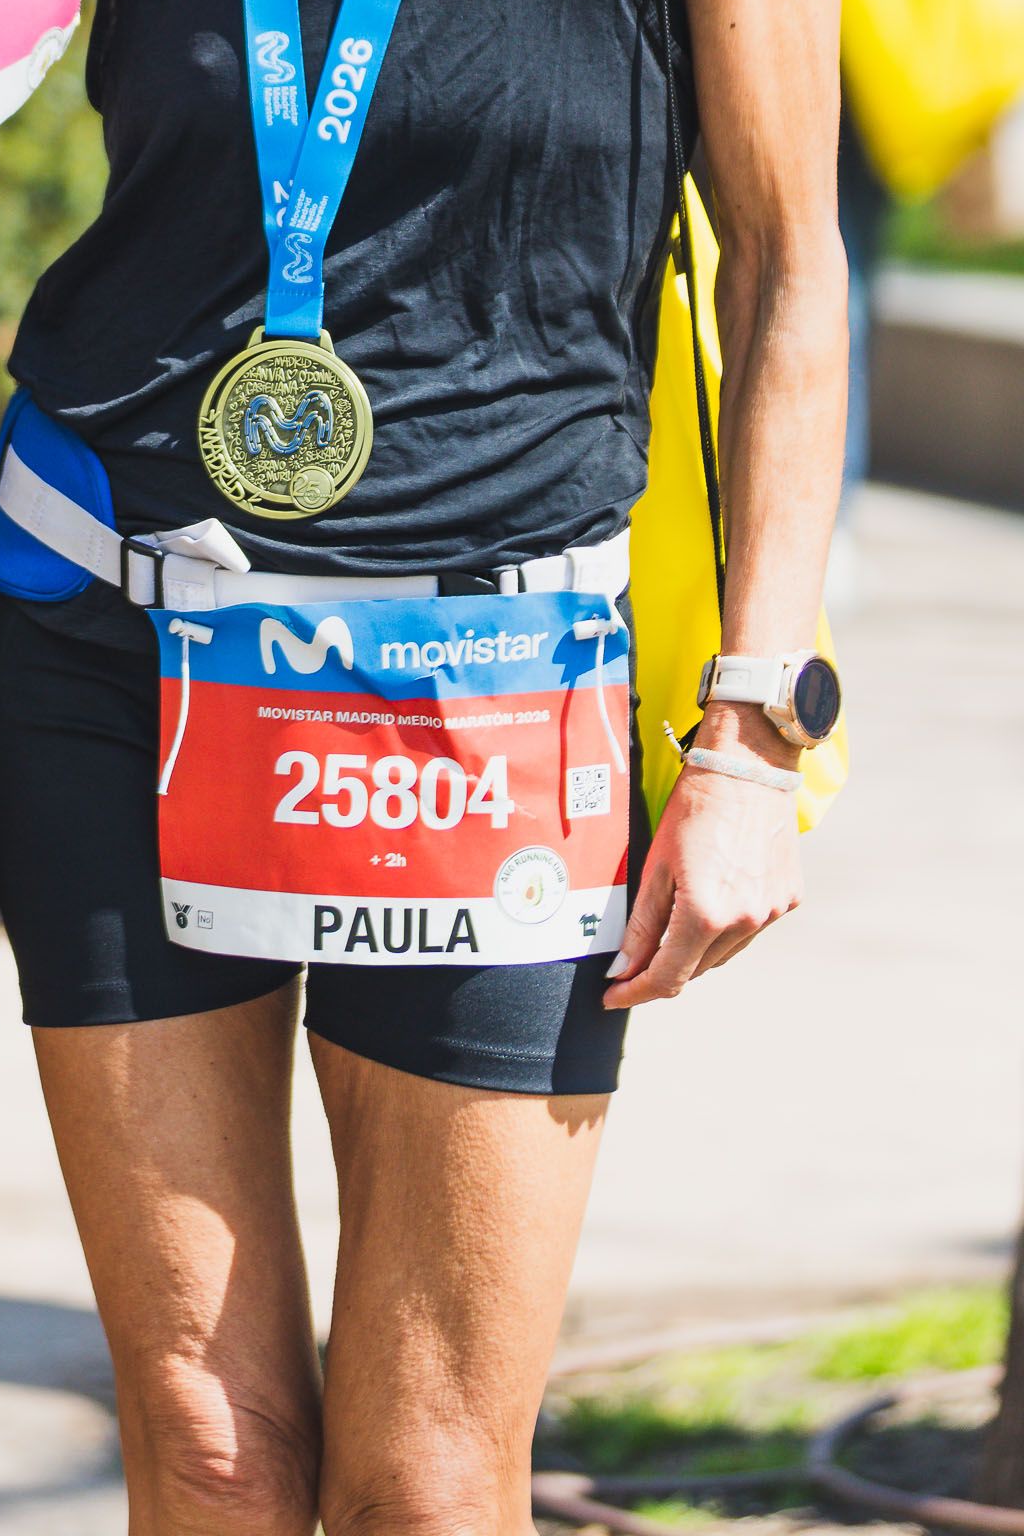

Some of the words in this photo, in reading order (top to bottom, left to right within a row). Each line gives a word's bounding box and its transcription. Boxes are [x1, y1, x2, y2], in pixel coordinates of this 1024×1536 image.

[317, 36, 374, 145] 2026
[199, 427, 245, 502] MADRID
[380, 628, 549, 670] movistar
[258, 706, 334, 723] MOVISTAR
[336, 710, 396, 725] MADRID
[397, 713, 443, 729] MEDIO
[444, 711, 514, 730] MARATÓN
[514, 709, 551, 725] 2026
[273, 749, 516, 831] 25804
[384, 852, 407, 869] 2h
[313, 904, 480, 954] PAULA
